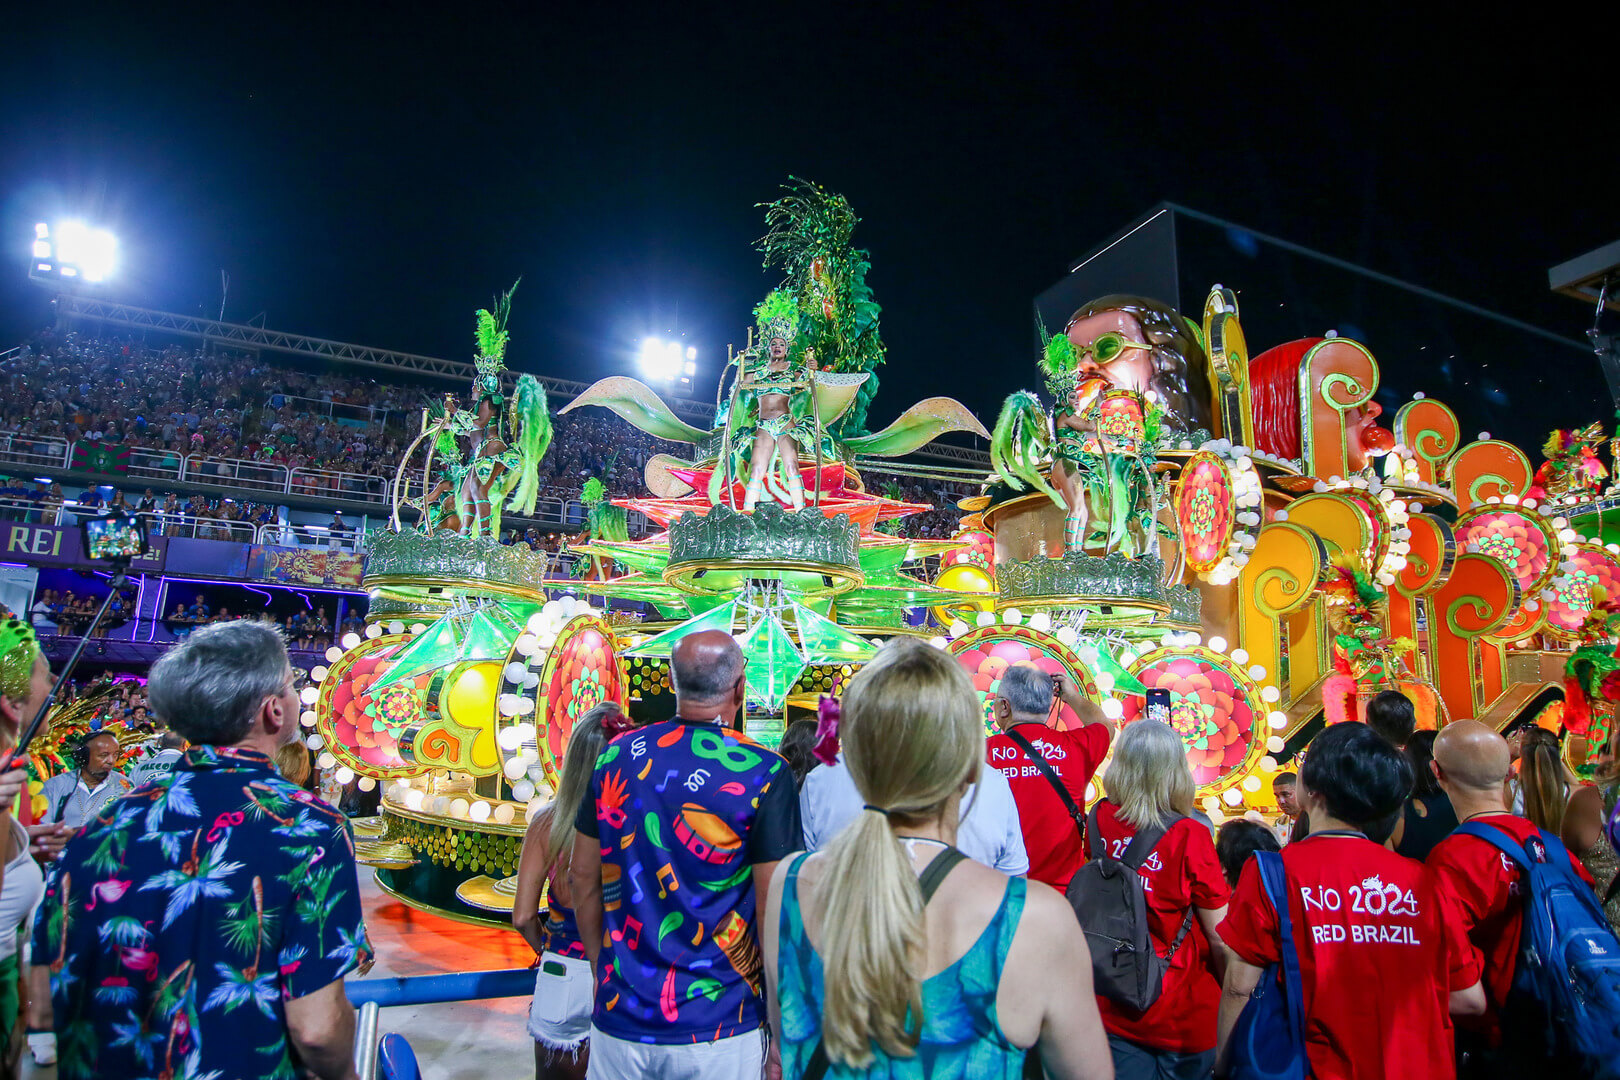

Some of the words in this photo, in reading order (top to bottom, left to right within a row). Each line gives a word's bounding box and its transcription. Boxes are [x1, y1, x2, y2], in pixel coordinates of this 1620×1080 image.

[7, 526, 63, 556] REI
[998, 767, 1019, 778] ED
[1348, 874, 1420, 916] 2024
[1312, 925, 1346, 944] RED
[1351, 925, 1420, 945] BRAZIL
